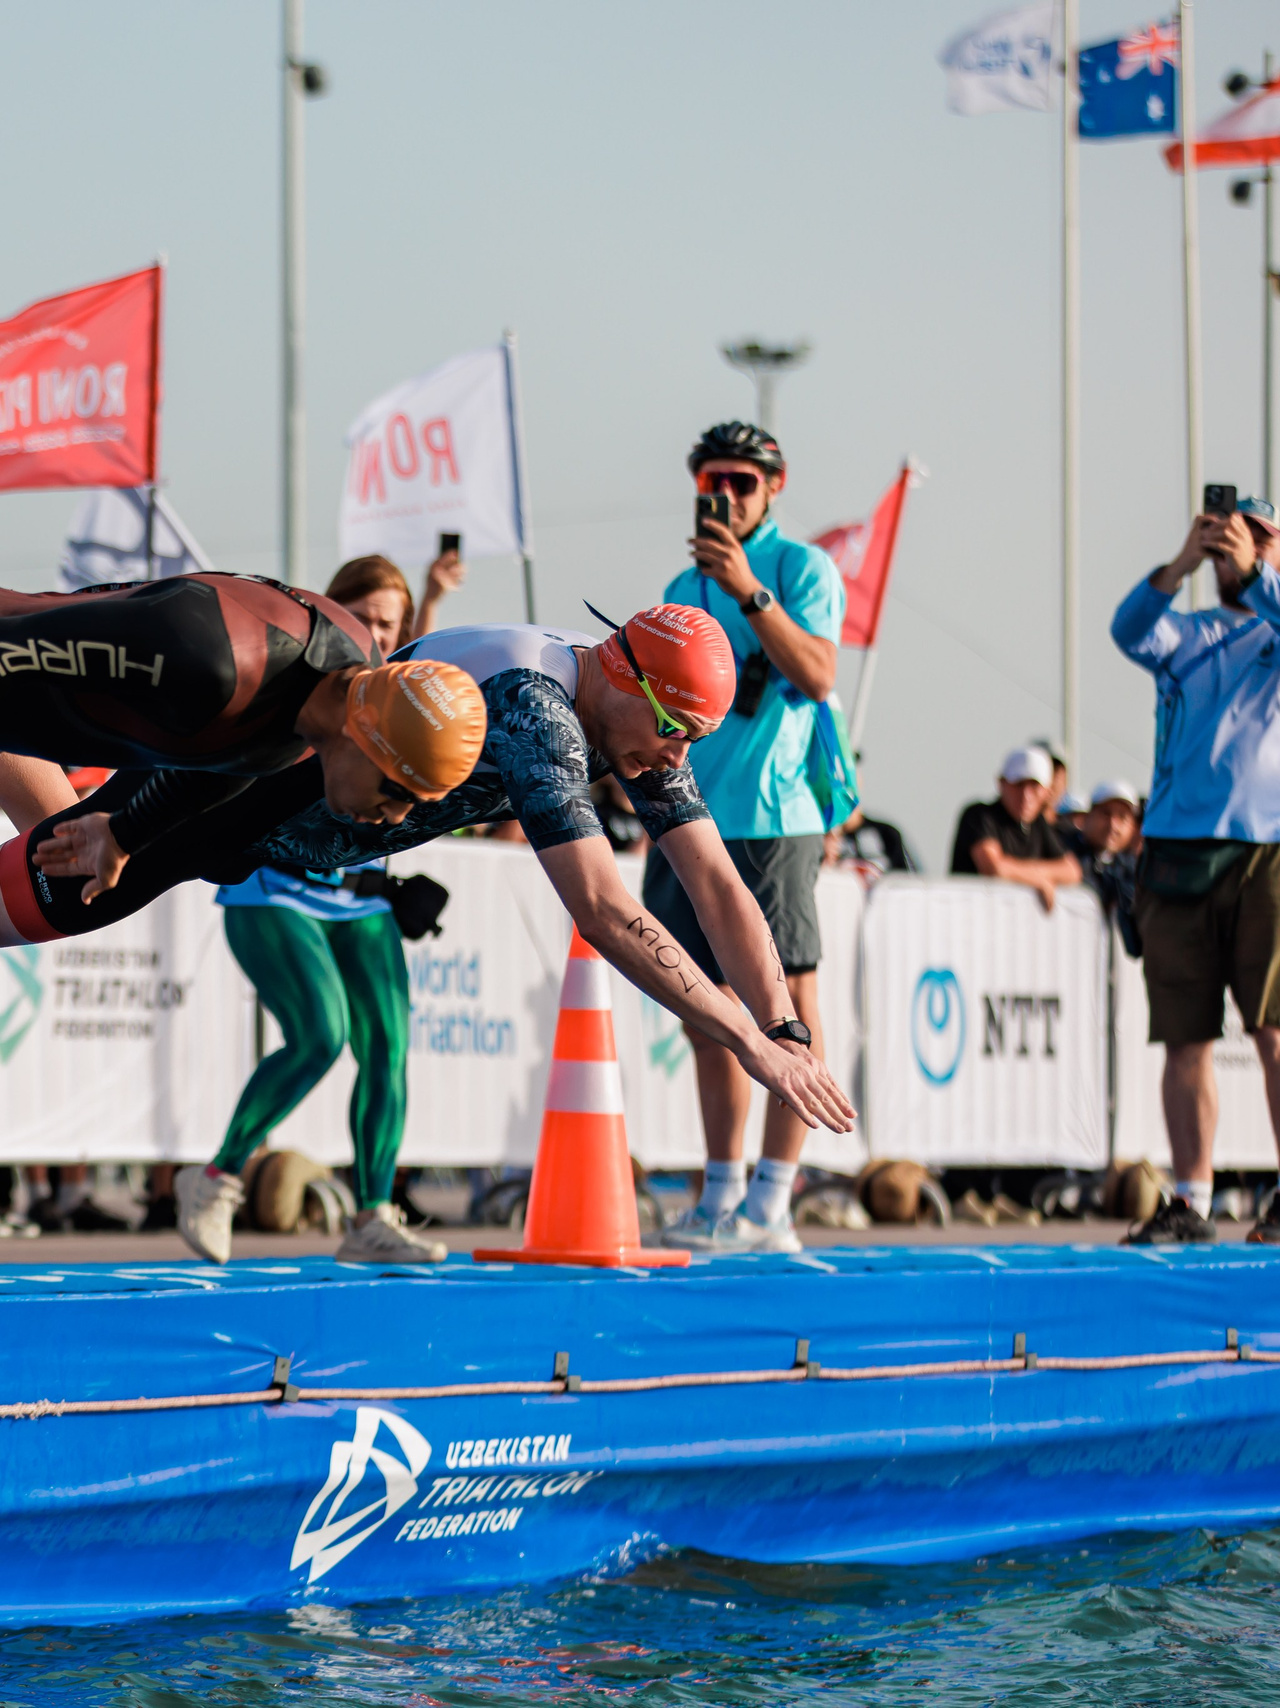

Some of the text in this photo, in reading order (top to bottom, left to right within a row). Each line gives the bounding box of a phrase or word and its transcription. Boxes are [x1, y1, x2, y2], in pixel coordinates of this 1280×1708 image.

[646, 626, 688, 648] extraordinary
[657, 615, 694, 636] Triathlon
[420, 679, 456, 720] Triathlon
[627, 917, 712, 995] 304
[981, 992, 1062, 1059] NTT
[446, 1433, 572, 1469] UZBEKISTAN
[418, 1469, 604, 1509] TRIATHLON
[394, 1507, 524, 1543] FEDERATION
